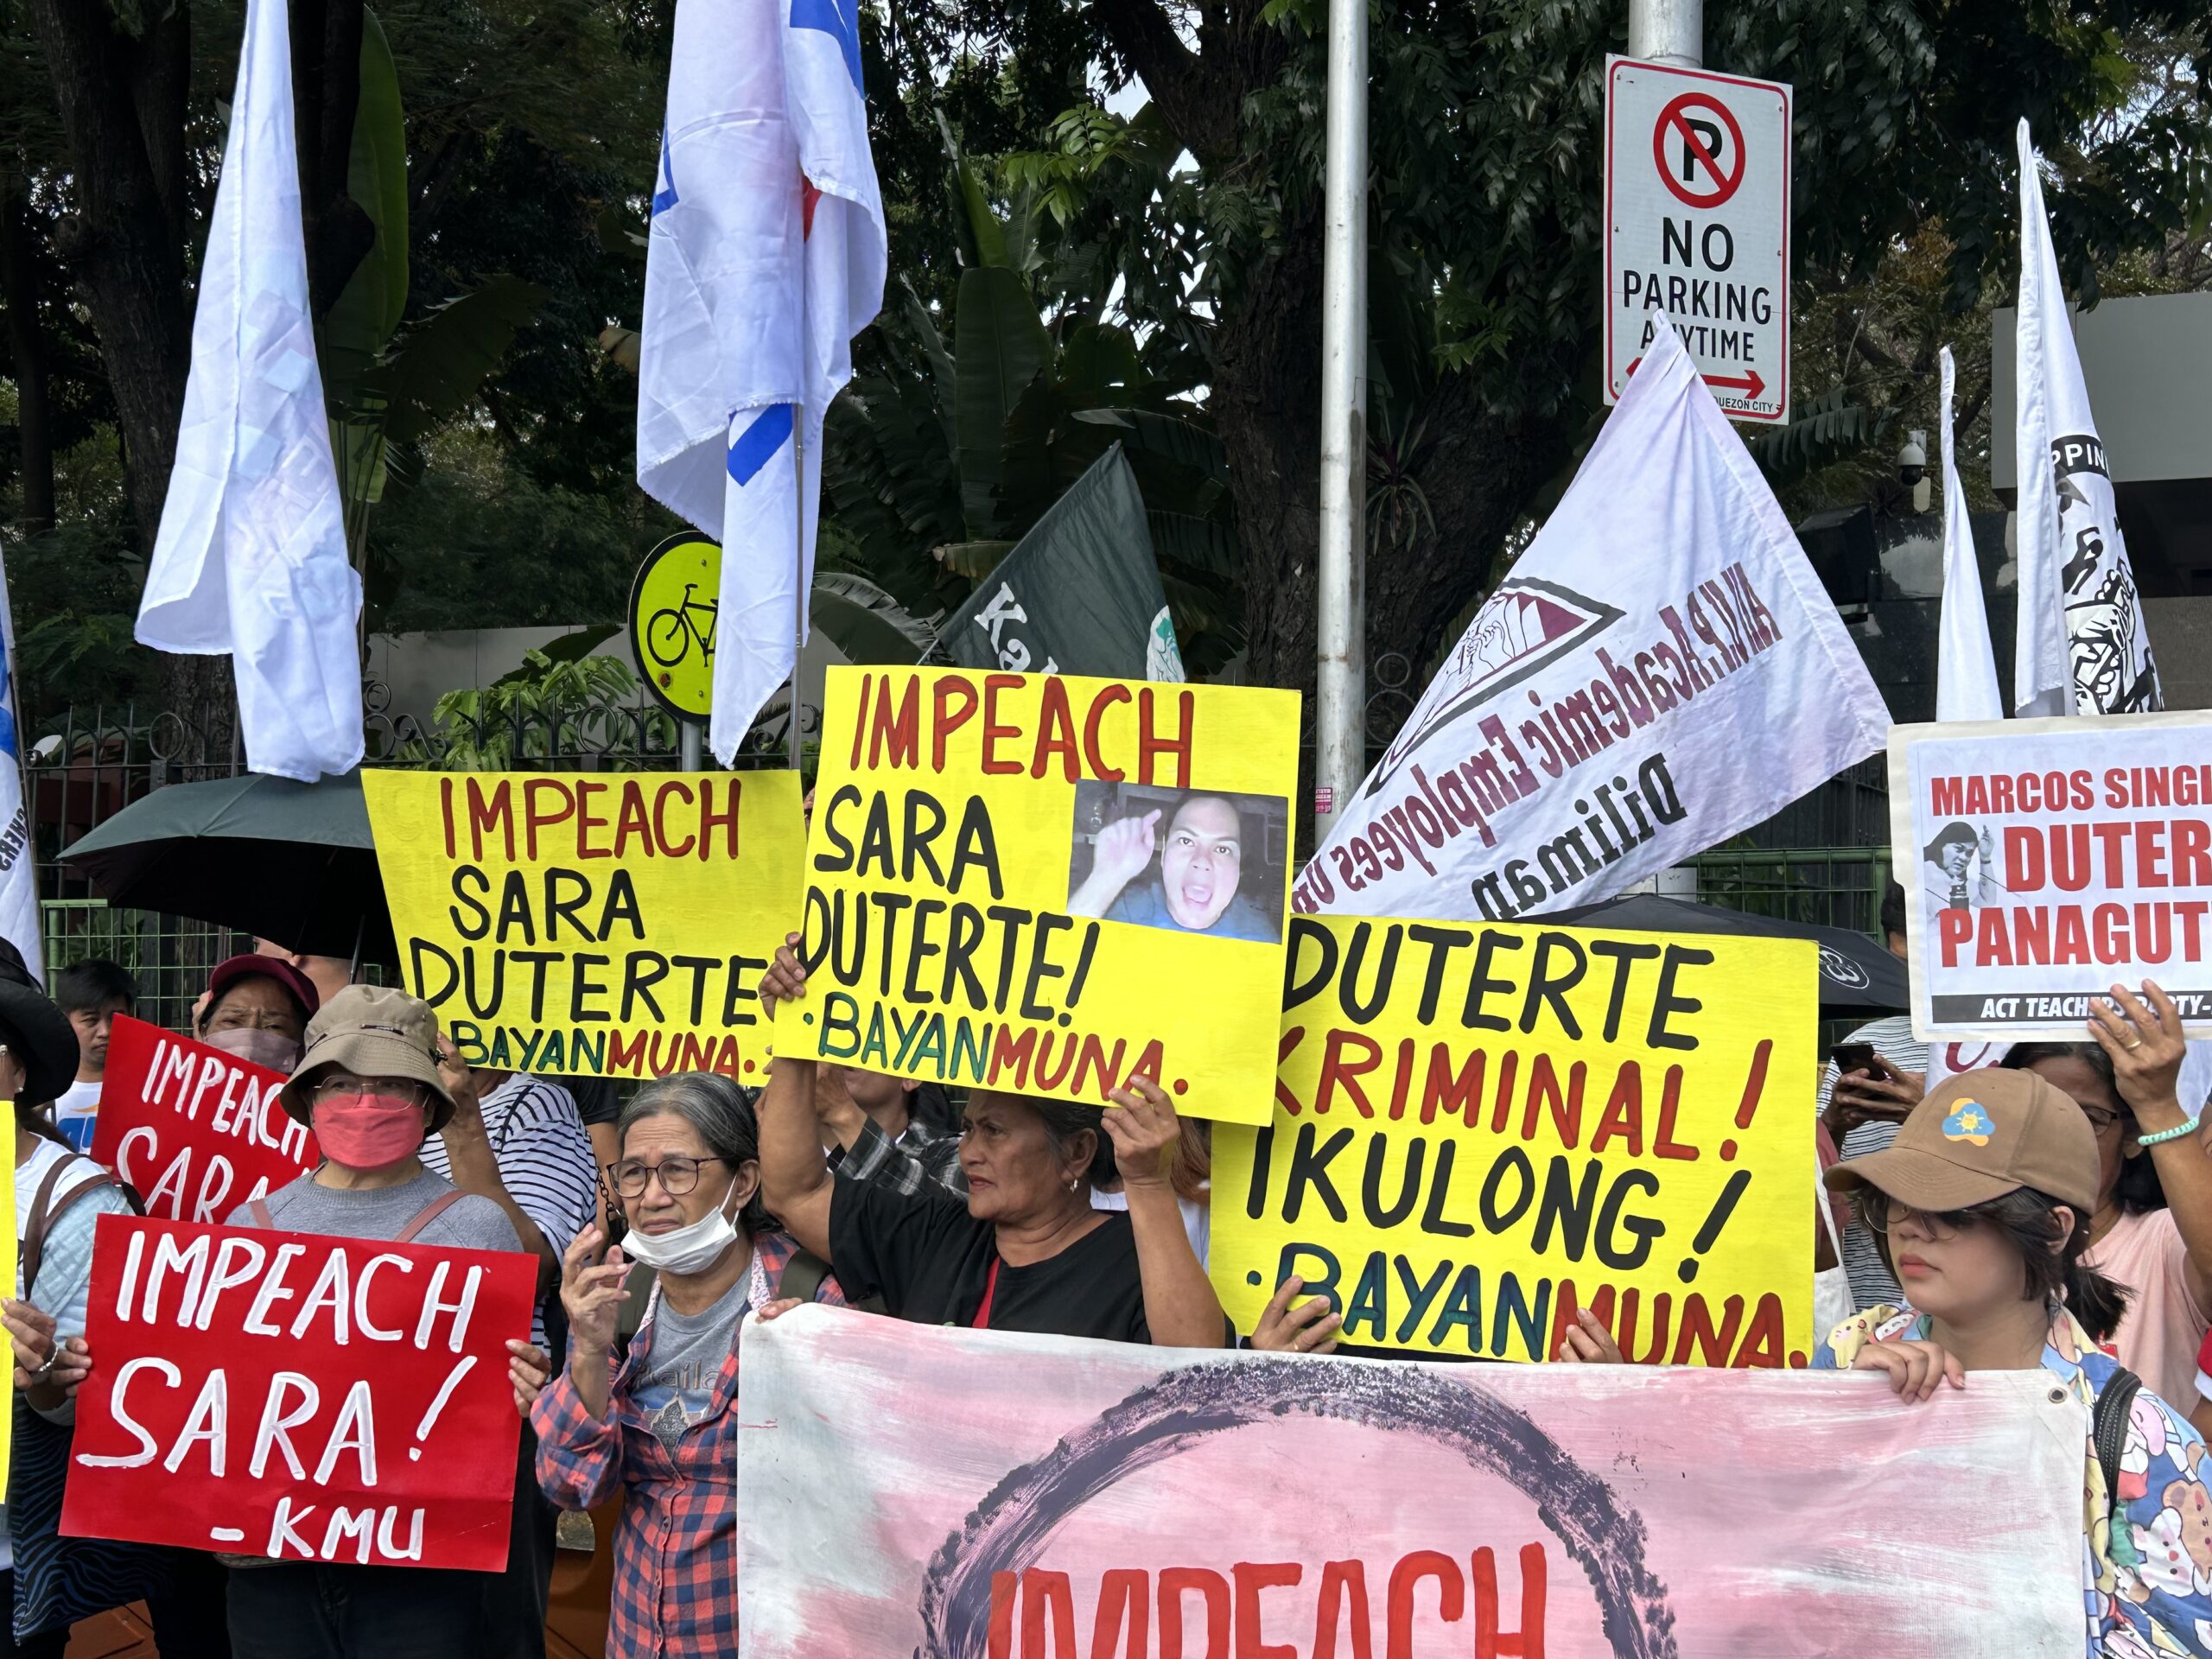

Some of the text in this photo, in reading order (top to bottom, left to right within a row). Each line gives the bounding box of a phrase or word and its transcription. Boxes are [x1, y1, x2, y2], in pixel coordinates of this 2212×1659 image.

[1662, 217, 1734, 272] NO
[1624, 270, 1771, 325] PARKING
[1640, 320, 1755, 362] AYTIME
[1752, 401, 1773, 412] CITY
[974, 582, 1058, 675] Ka
[850, 674, 1194, 788] IMPEACH
[441, 777, 741, 861] IMPEACH
[1931, 769, 2094, 817] MARCOS
[814, 784, 1004, 899] SARA
[2004, 819, 2212, 892] DUTER
[449, 864, 645, 945] SARA
[1939, 901, 2212, 968] PANAGUT
[410, 937, 768, 1027] DUTERTE
[798, 886, 1101, 1027] DUTERTE!
[1282, 917, 1714, 1050] DUTERTE
[1980, 998, 2020, 1019] ACT
[115, 1230, 482, 1353] IMPEACH
[75, 1355, 478, 1487] SARA!
[267, 1496, 425, 1565] KMU
